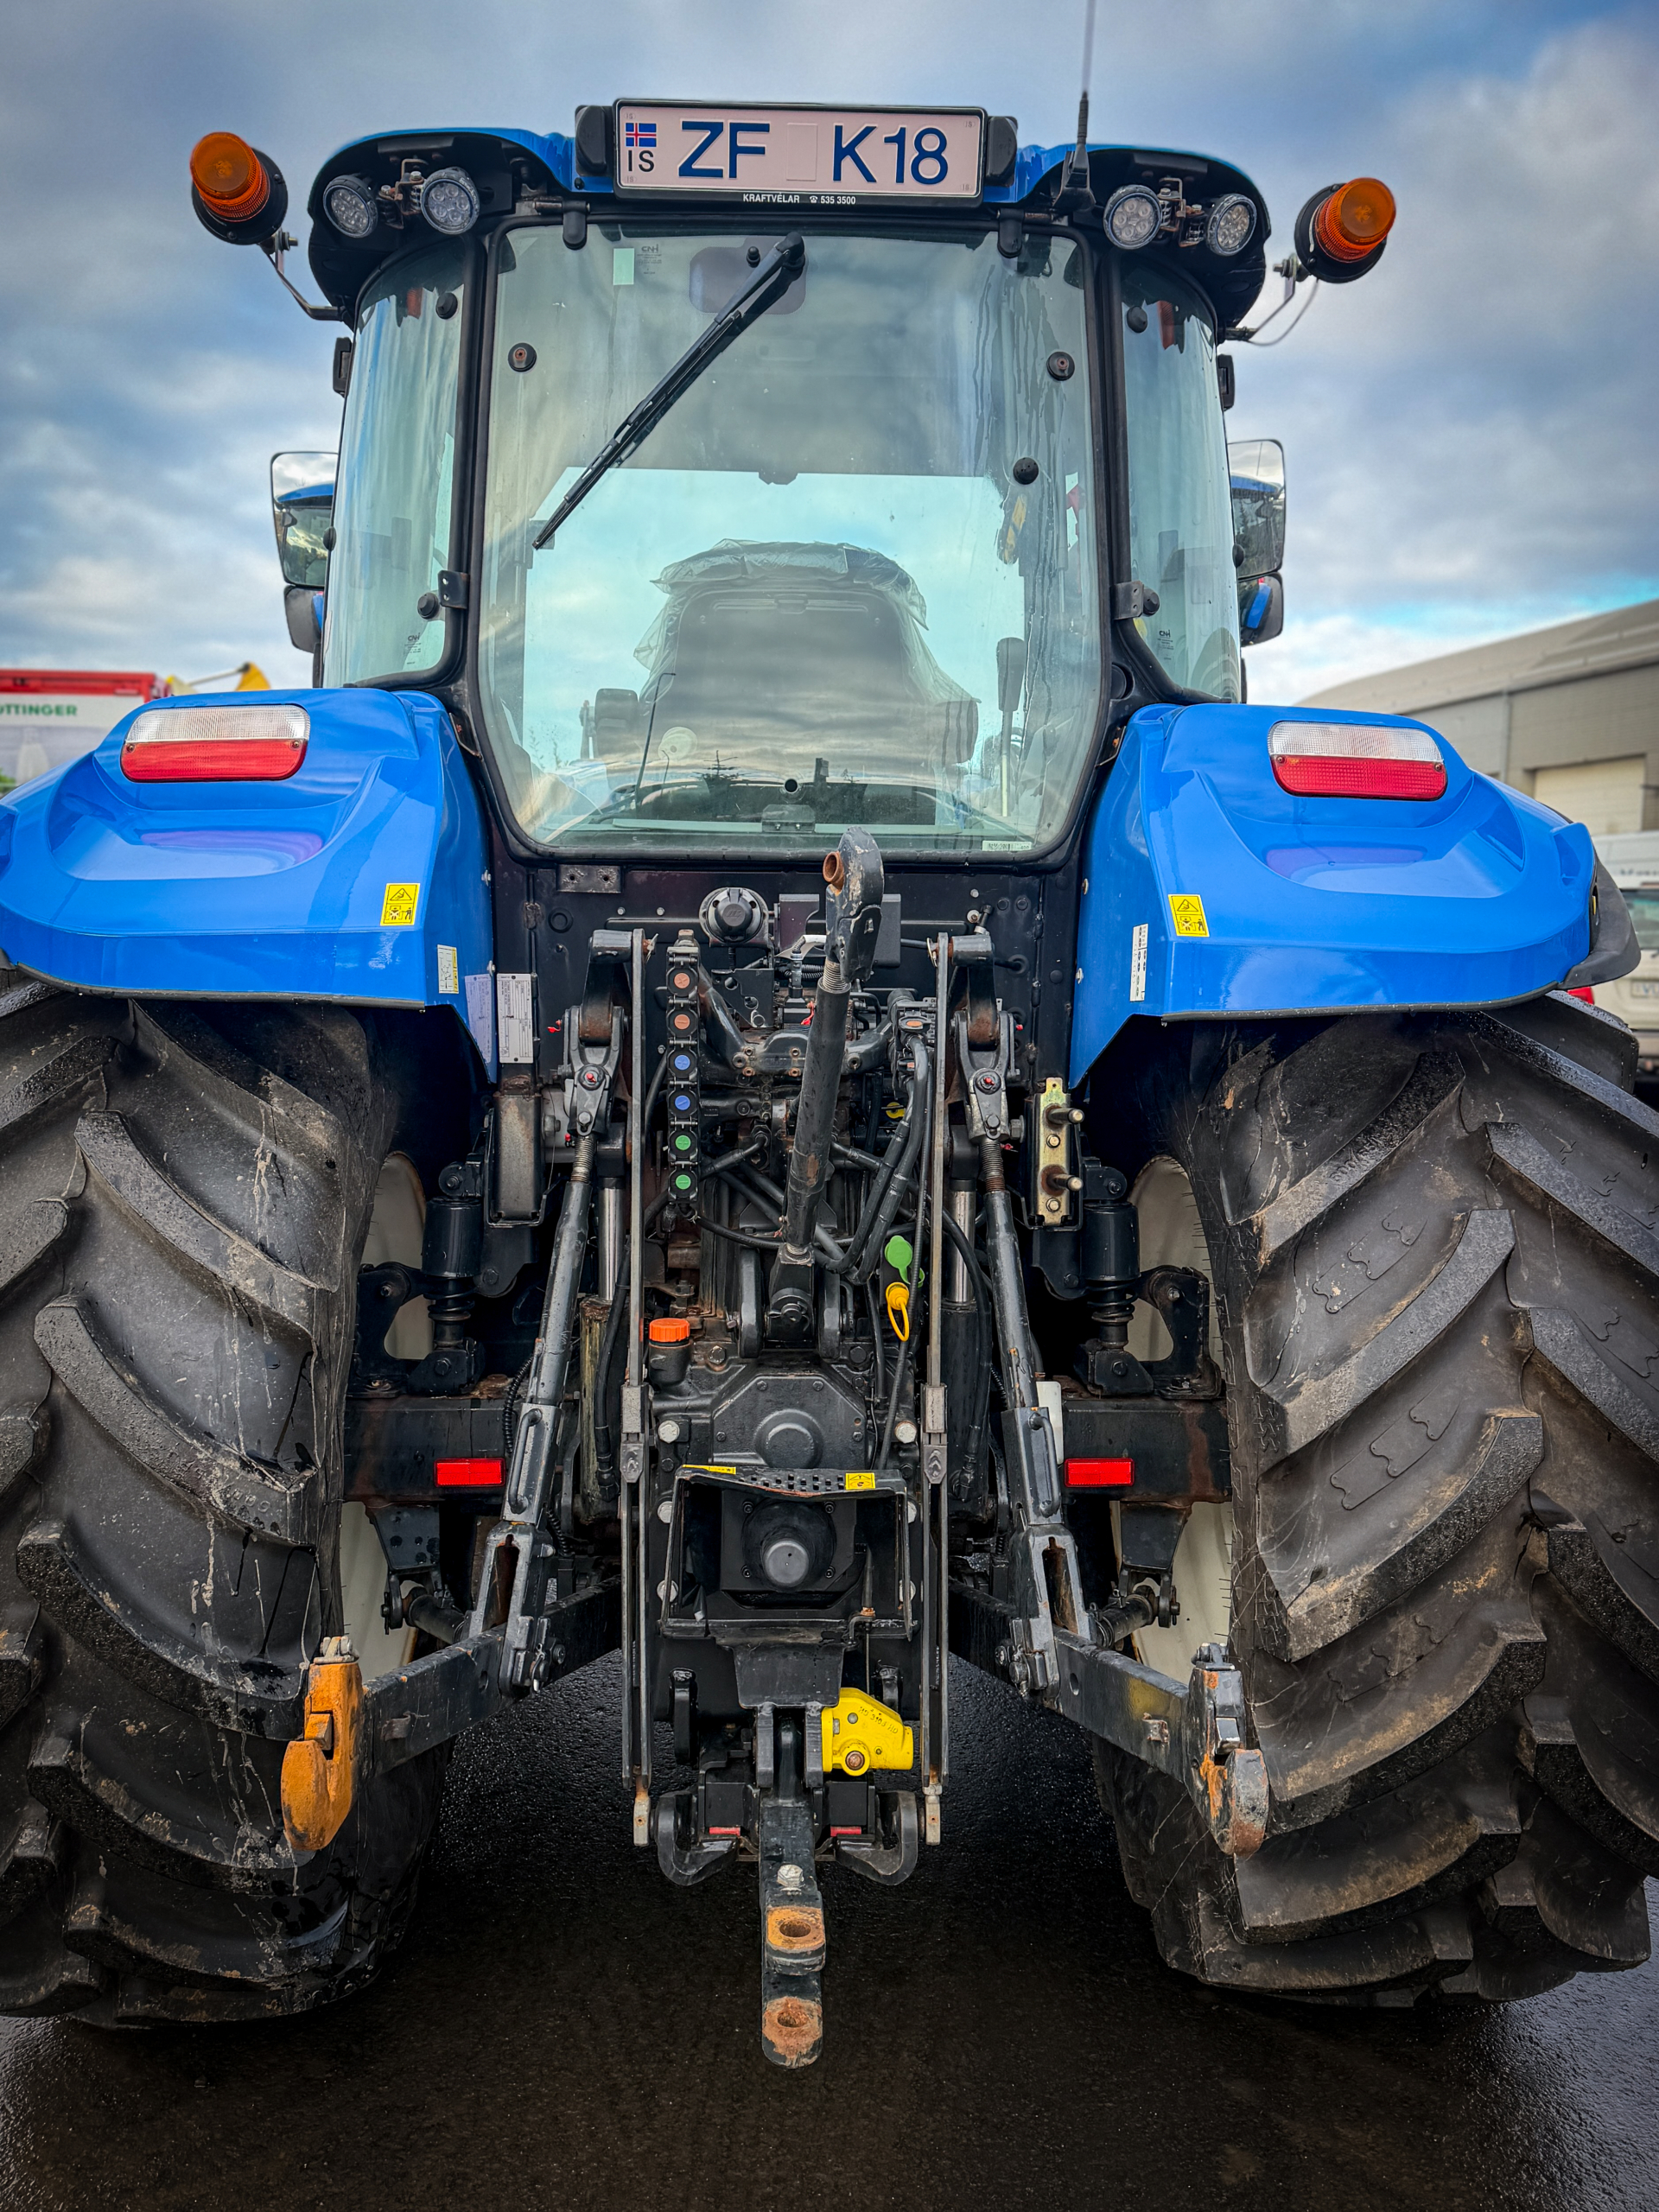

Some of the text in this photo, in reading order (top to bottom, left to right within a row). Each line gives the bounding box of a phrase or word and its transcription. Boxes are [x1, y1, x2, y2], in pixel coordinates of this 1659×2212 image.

[627, 149, 655, 172] IS
[678, 120, 949, 184] ZF K18
[742, 192, 856, 205] KRAFTVÉLAR 535 3500
